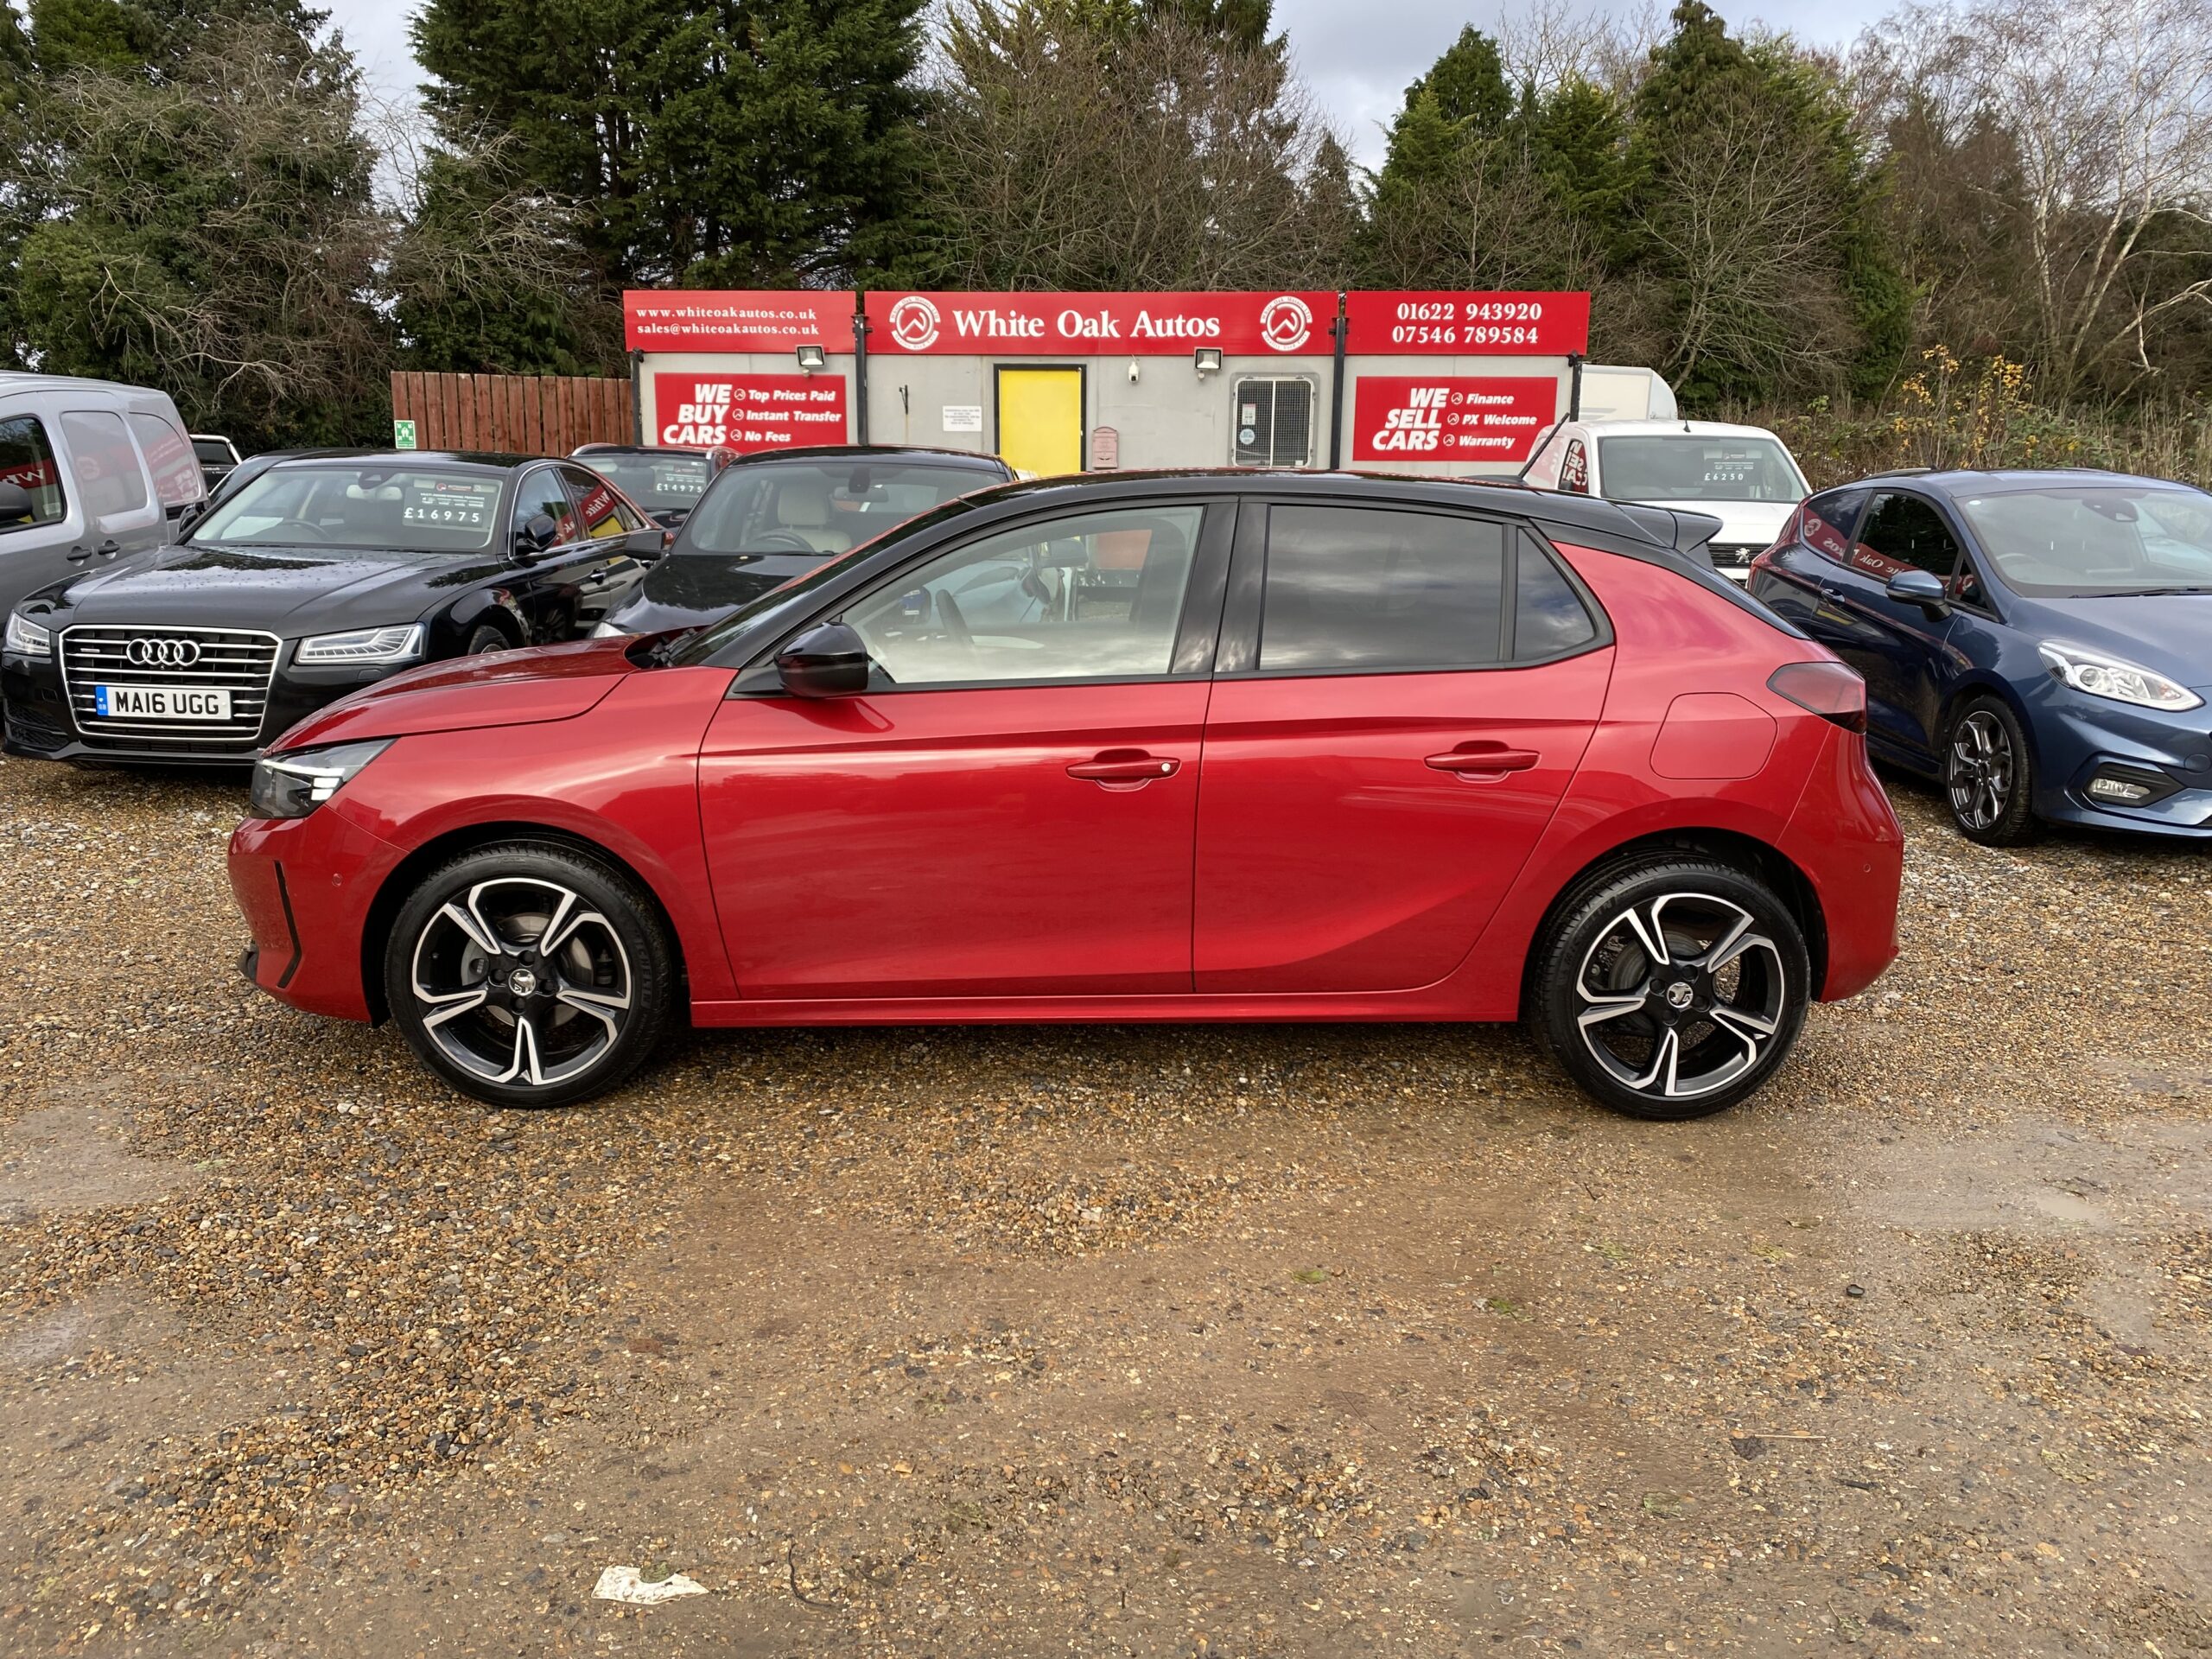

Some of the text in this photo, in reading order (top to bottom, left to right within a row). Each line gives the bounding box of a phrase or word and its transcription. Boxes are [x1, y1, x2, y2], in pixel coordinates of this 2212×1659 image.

[635, 306, 817, 321] www.whiteoakautos.co.uk
[1396, 302, 1542, 321] 01622 943920
[637, 322, 820, 335] sales@whiteoakautos.co.uk
[952, 308, 1221, 339] White Oak Autos
[1392, 326, 1539, 344] 07546 789584
[695, 384, 733, 404] WE
[748, 390, 836, 404] Top Prices Paid
[1409, 387, 1451, 408] WE
[1466, 392, 1515, 404] Finance
[677, 404, 730, 424] BUY
[746, 410, 842, 423] Instant Transfer
[1384, 408, 1442, 429] SELL
[1462, 414, 1537, 425] PX Welcome
[663, 424, 728, 446] CARS
[744, 430, 791, 442] No Fees
[1372, 429, 1440, 451] CARS
[1459, 434, 1516, 449] Warranty
[1704, 473, 1744, 481] £6250
[657, 483, 702, 493] £14975
[404, 507, 480, 523] £16975
[115, 691, 219, 715] MA16 UGG
